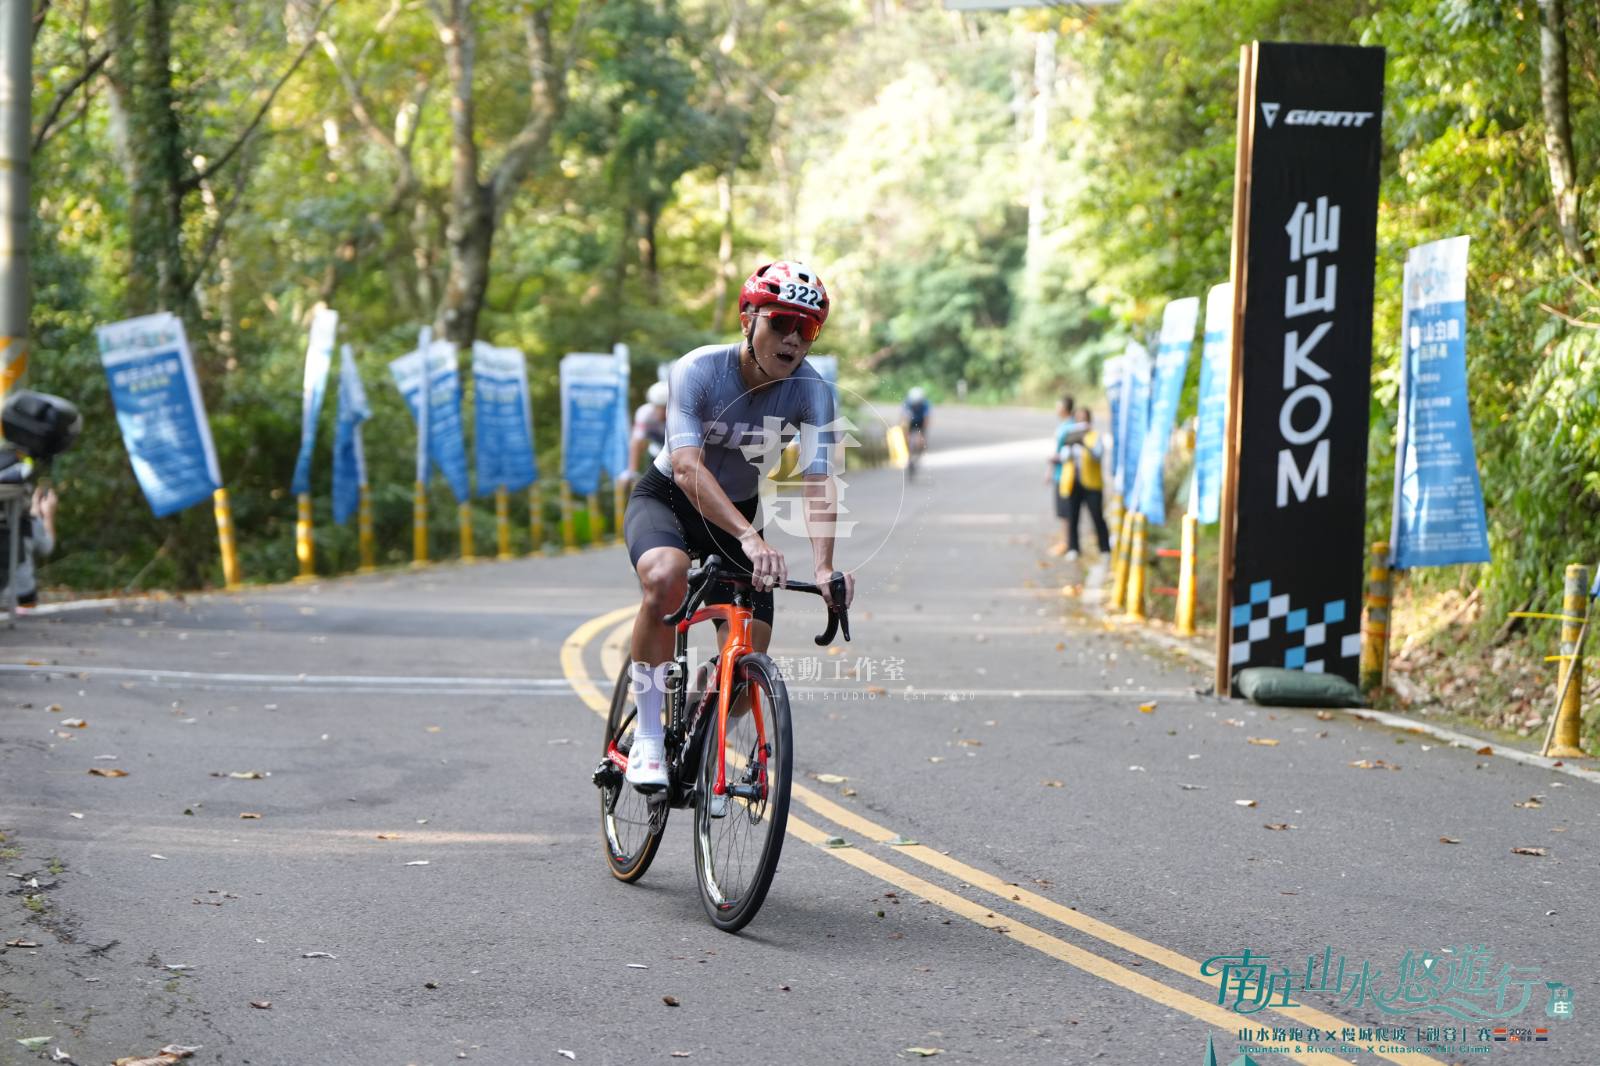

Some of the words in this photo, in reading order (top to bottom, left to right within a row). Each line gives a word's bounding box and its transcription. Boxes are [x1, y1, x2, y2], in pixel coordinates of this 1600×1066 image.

[1284, 109, 1374, 127] GIANT
[1285, 196, 1341, 319] 仙山
[786, 283, 819, 306] 322
[1276, 321, 1334, 508] KOM
